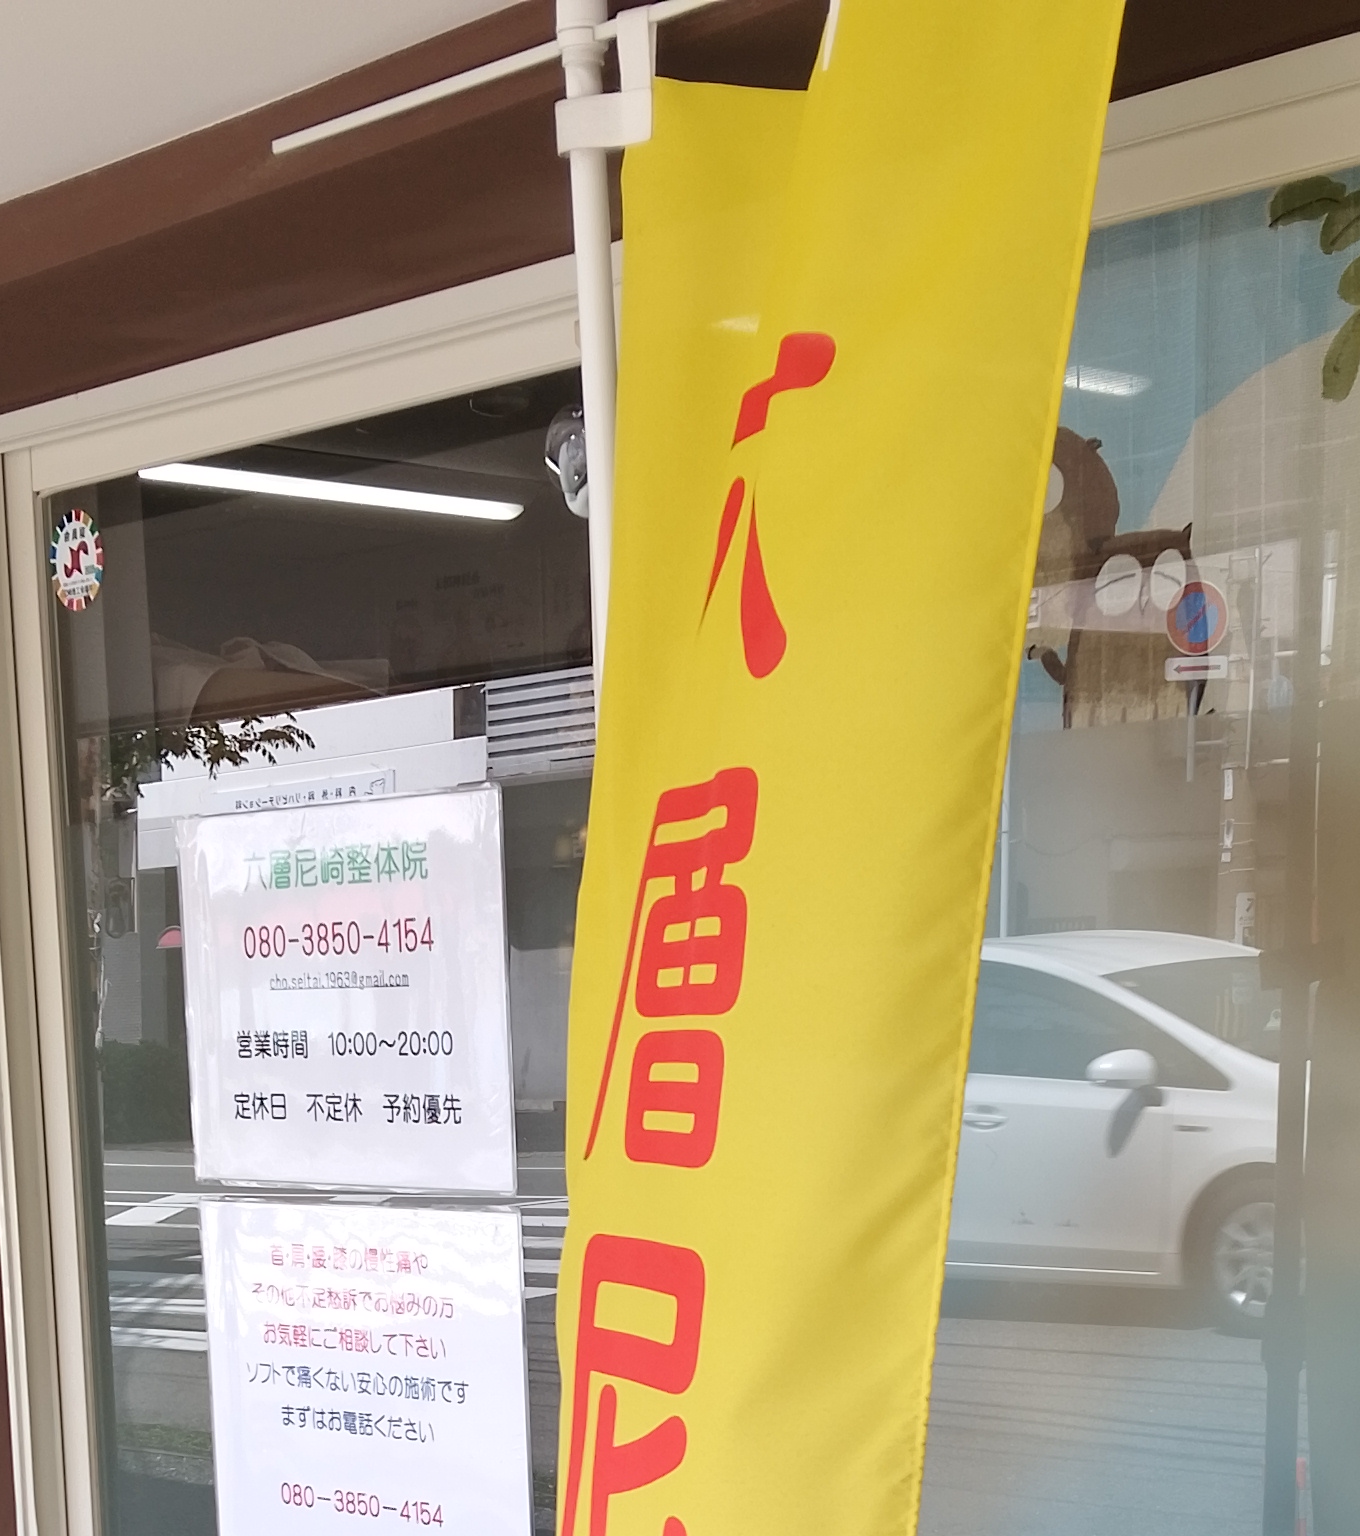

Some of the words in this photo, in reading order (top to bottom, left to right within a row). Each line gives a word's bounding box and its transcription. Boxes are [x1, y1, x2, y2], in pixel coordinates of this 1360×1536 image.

[243, 840, 428, 893] 六層尼崎整体院
[243, 916, 435, 959] 080-3850-4154
[236, 1030, 309, 1060] 営業時間
[234, 1093, 287, 1121] 定休日
[306, 1093, 364, 1123] 不定休
[383, 1094, 463, 1126] 予約優先
[263, 1322, 447, 1360] お気軽にご相談して下さい
[246, 1361, 469, 1404] ソフトで痛くない安心の施術です
[281, 1404, 436, 1443] まずはお電話ください
[281, 1482, 444, 1528] 080-3850-4154
